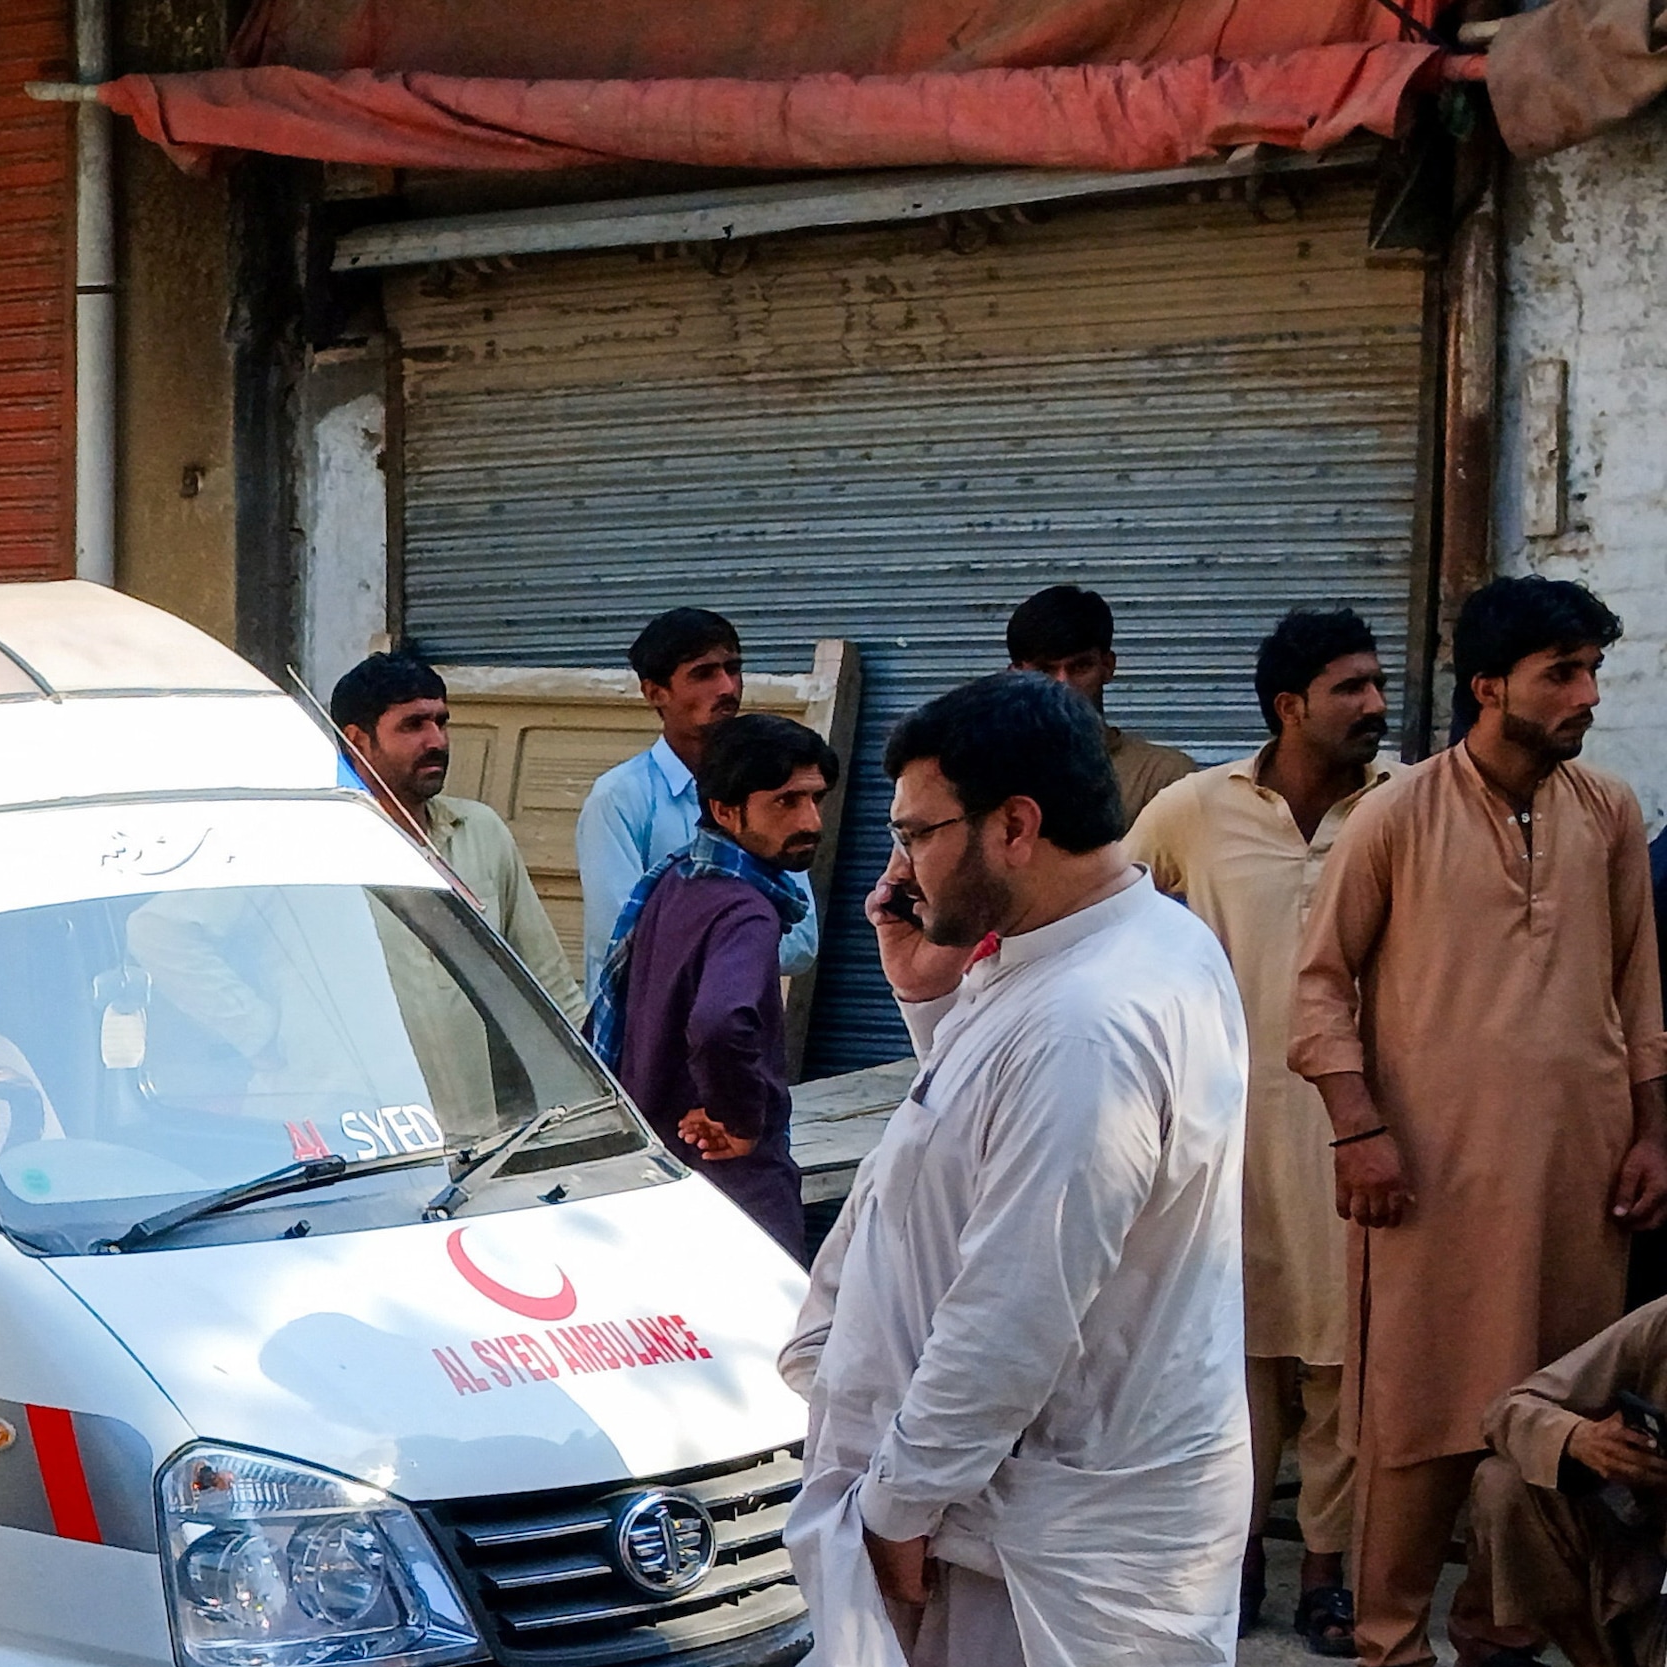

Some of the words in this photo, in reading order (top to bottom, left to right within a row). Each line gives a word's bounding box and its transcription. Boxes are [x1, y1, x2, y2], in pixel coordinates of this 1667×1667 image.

[340, 1103, 445, 1161] SYED
[432, 1346, 492, 1396] AL
[470, 1333, 560, 1388] SYED
[545, 1314, 714, 1375] AMBULANCE
